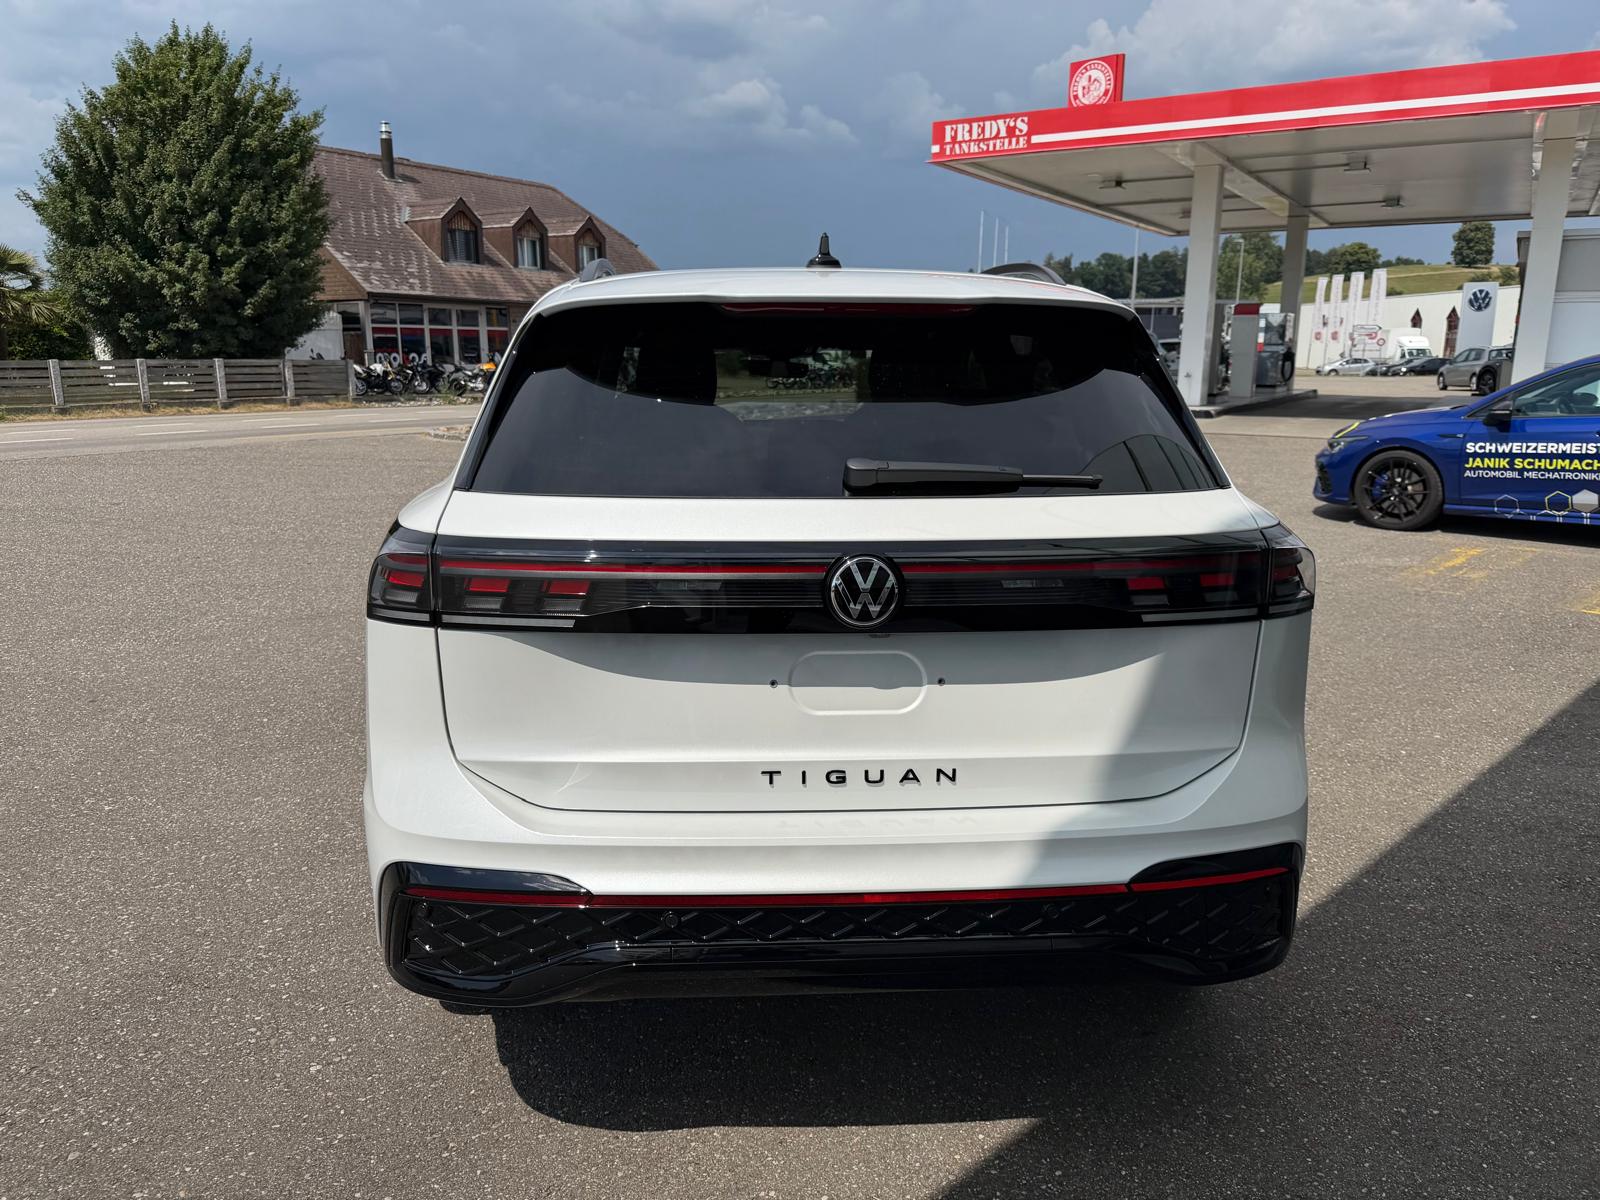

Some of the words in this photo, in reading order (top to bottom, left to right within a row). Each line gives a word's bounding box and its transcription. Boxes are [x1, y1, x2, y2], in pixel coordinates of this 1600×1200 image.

[944, 117, 1029, 143] FREDY'S
[944, 136, 1028, 156] TANKSTELLE
[1464, 457, 1510, 469] JANIK
[1513, 458, 1600, 471] SCHUMACH
[1464, 470, 1522, 479] AUTOMOBIL
[1523, 471, 1600, 481] MECHATRONIK
[760, 768, 958, 786] TIGUAN
